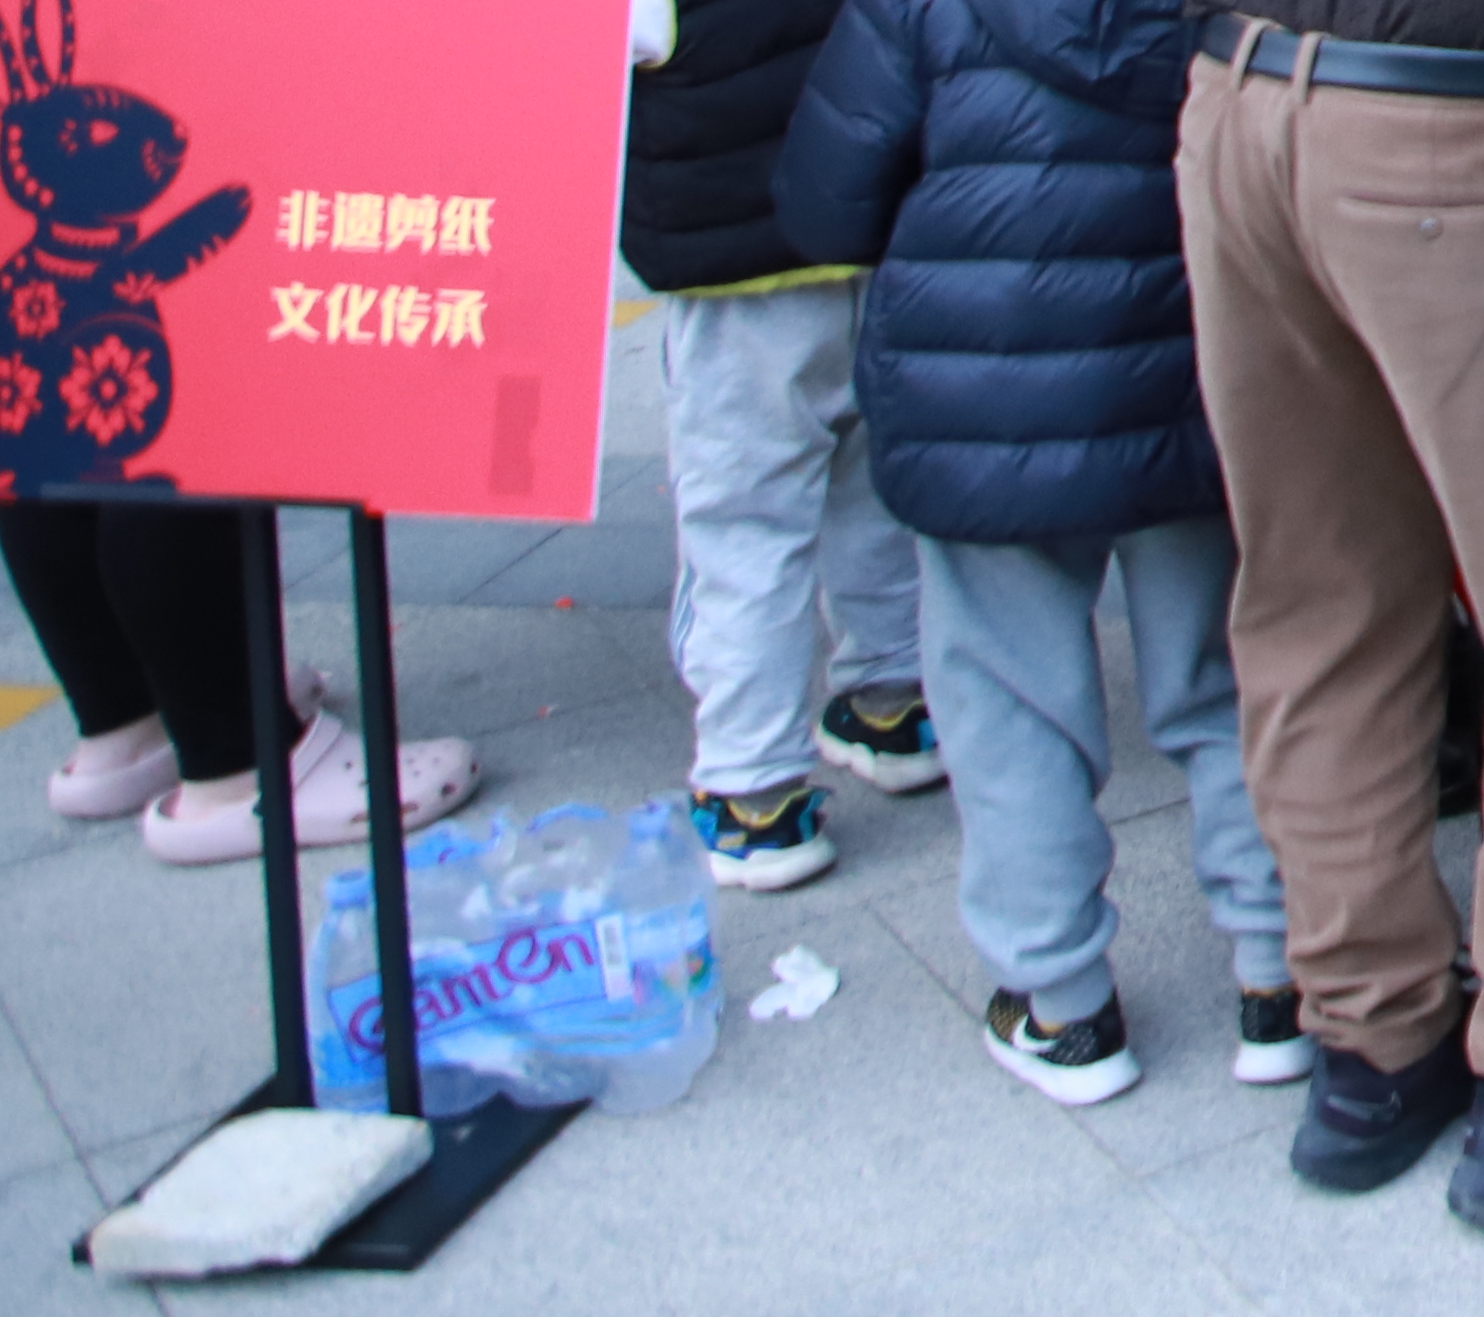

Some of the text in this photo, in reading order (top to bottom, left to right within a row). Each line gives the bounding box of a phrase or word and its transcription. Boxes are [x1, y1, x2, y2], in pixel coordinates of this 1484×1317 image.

[275, 189, 497, 255] 非遗剪纸
[267, 282, 488, 348] 文化传承
